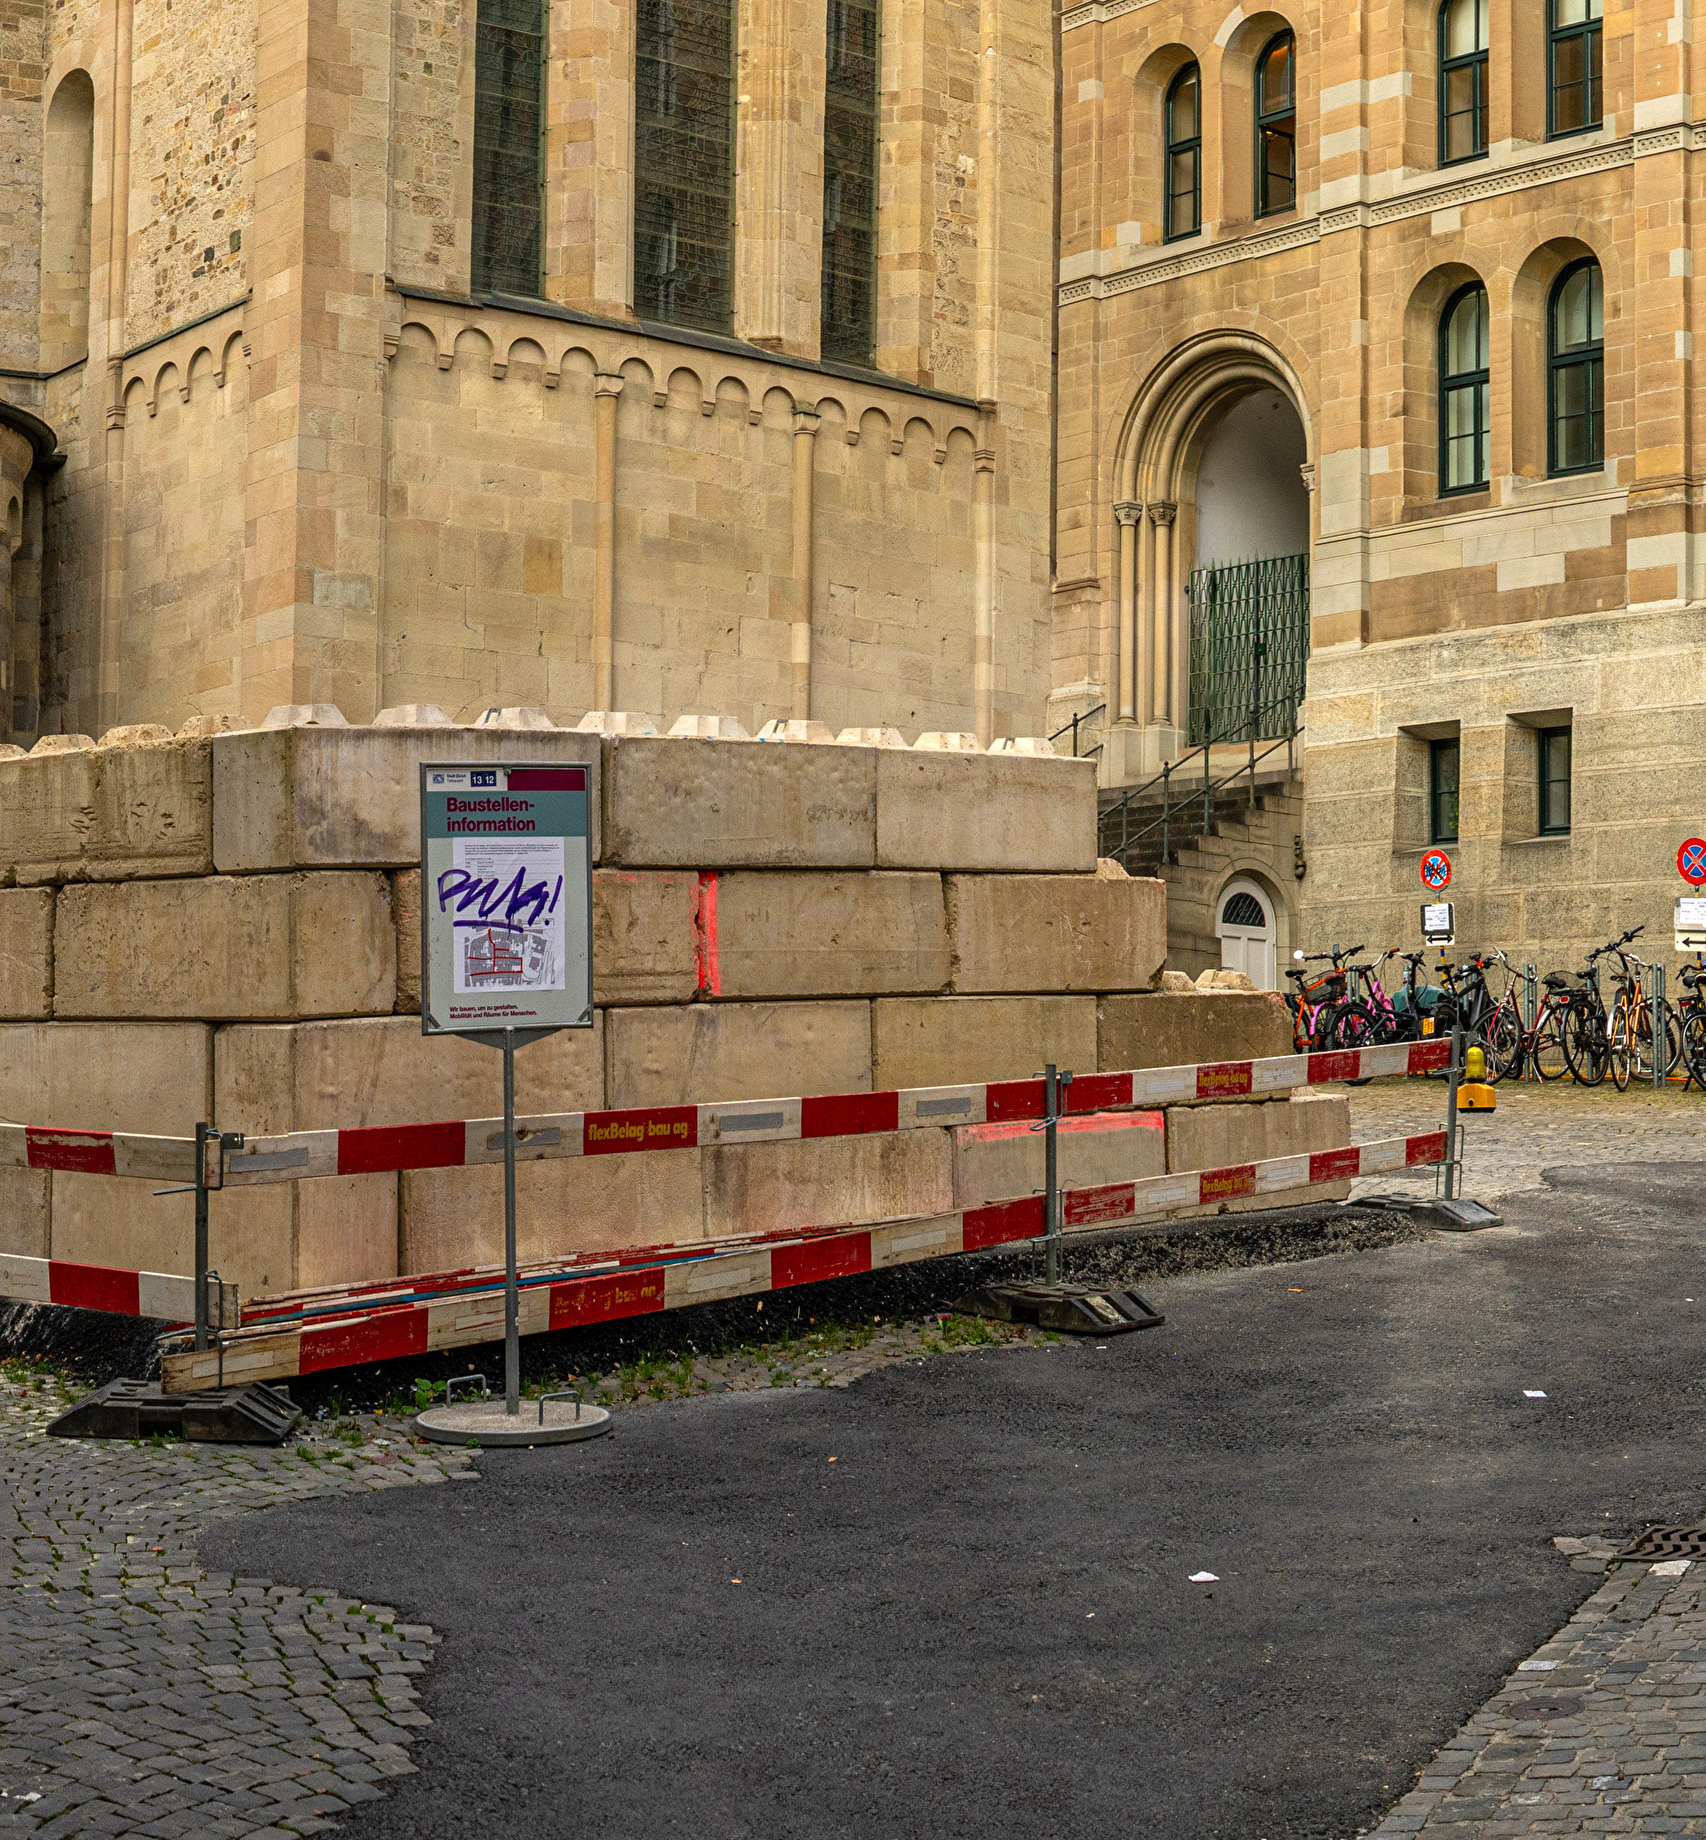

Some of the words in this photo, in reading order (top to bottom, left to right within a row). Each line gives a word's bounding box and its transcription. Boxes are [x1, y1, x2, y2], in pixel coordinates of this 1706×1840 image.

[472, 775, 482, 784] 13
[485, 775, 494, 784] 12
[446, 797, 535, 813] Baustellen-
[447, 816, 536, 832] information
[588, 1121, 644, 1142] flexBelag
[648, 1120, 671, 1136] bau
[673, 1122, 688, 1139] ag
